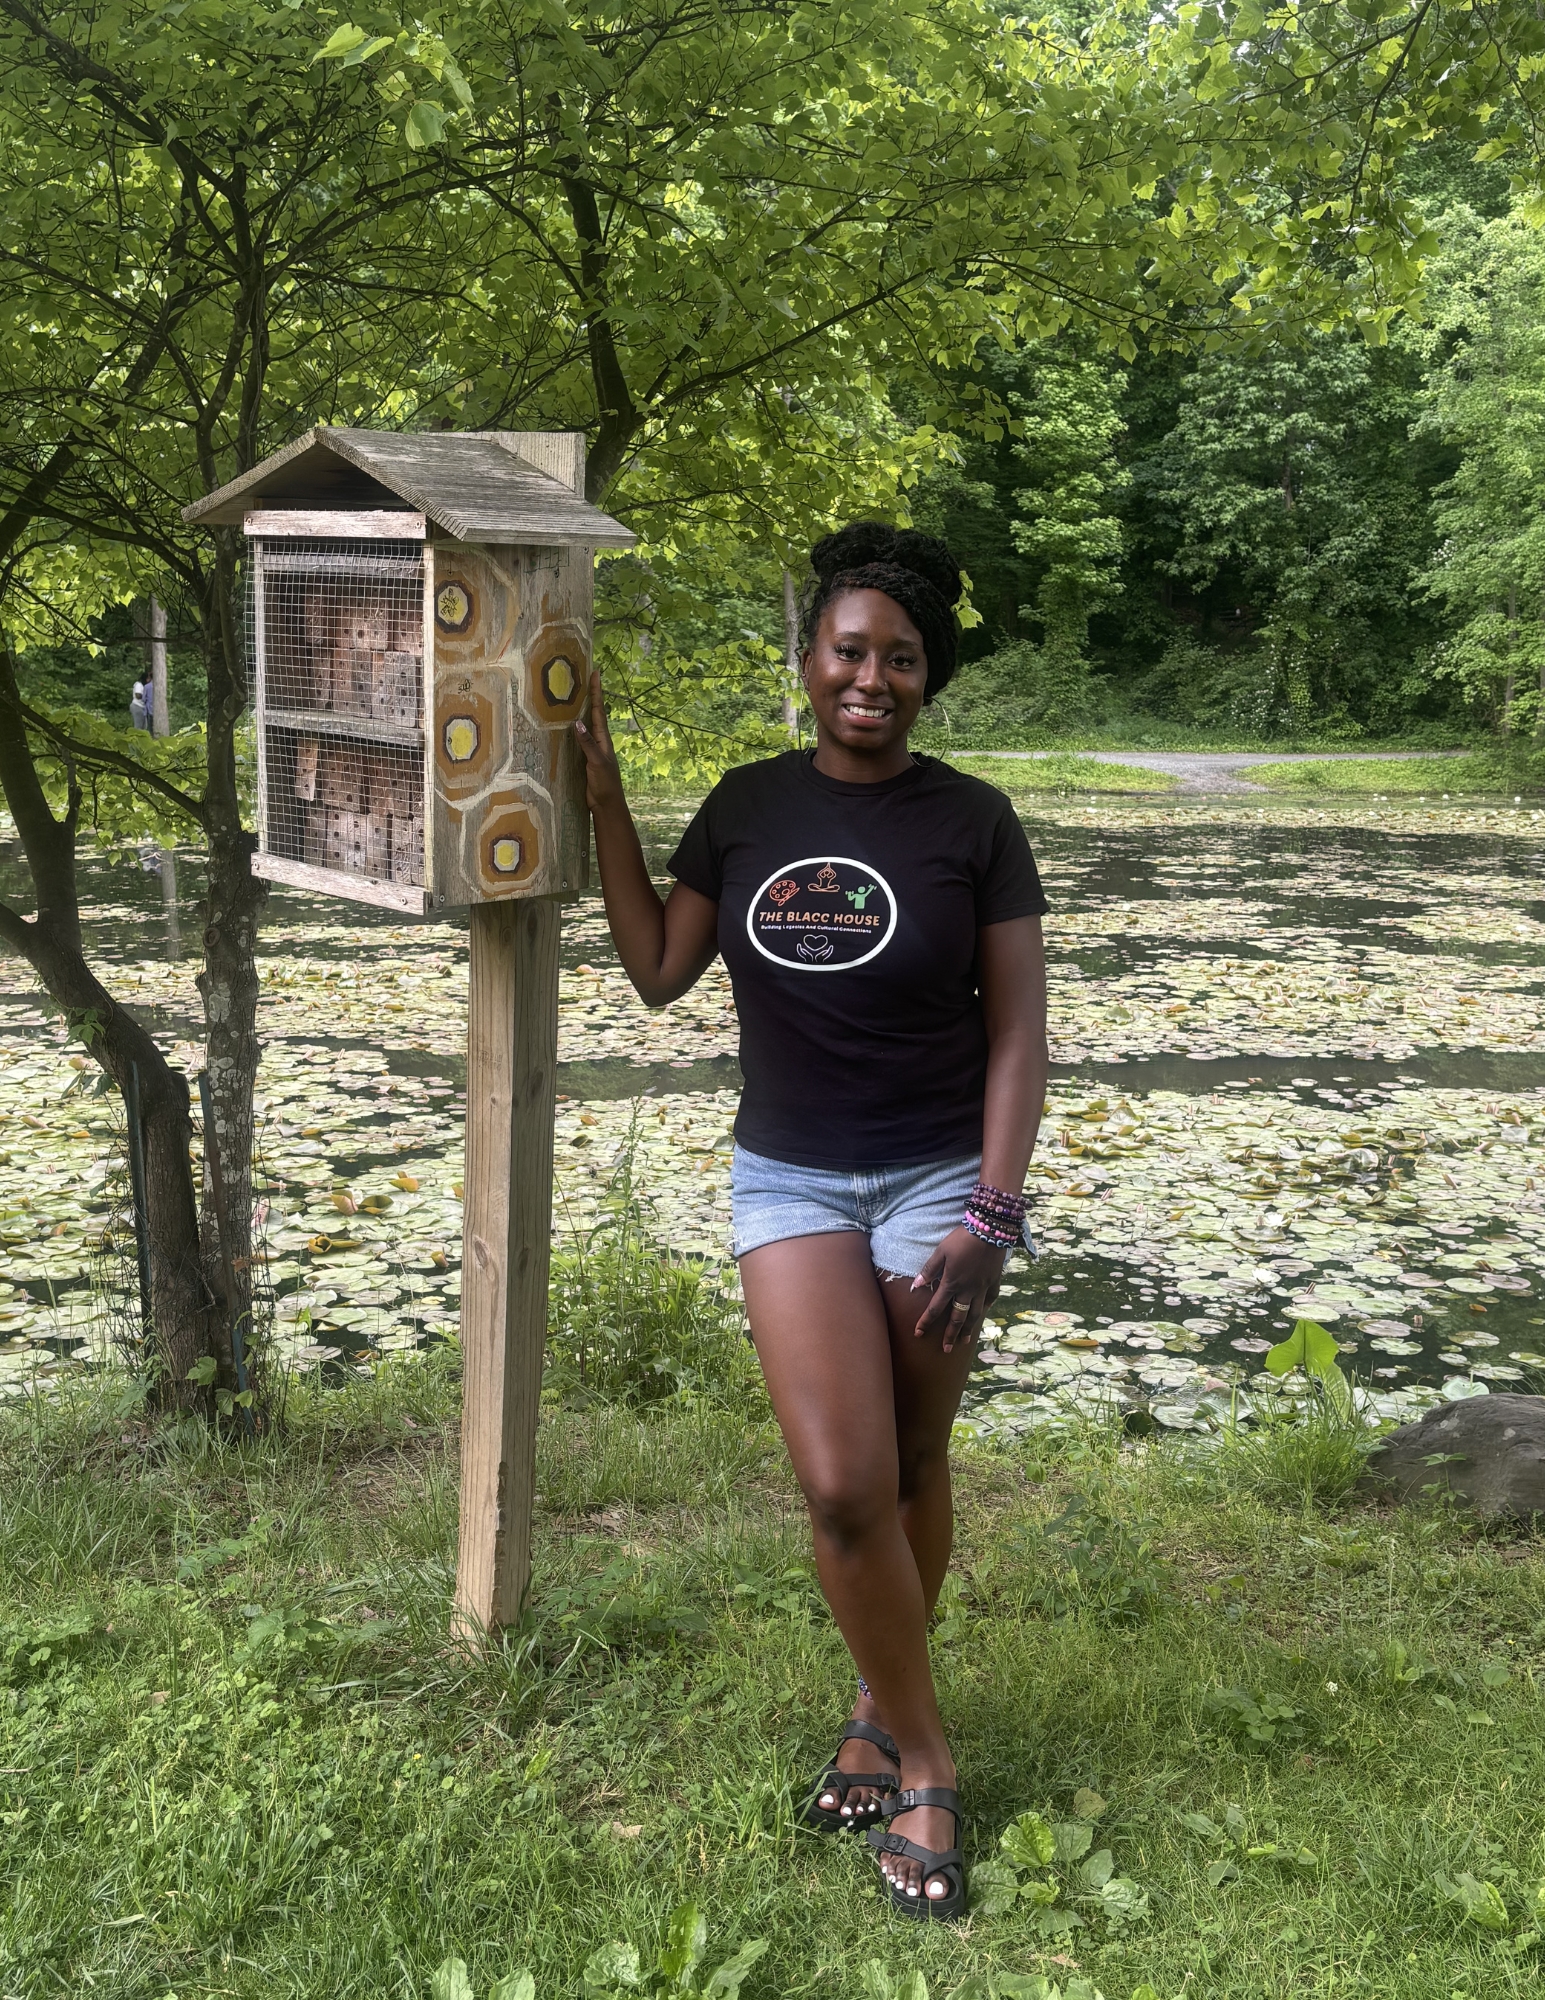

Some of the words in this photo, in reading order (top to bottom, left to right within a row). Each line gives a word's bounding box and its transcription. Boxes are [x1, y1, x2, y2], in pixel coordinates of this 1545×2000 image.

[759, 911, 784, 922] THE
[786, 911, 830, 923] BLACC
[833, 913, 880, 926] HOUSE
[839, 926, 872, 934] Connections
